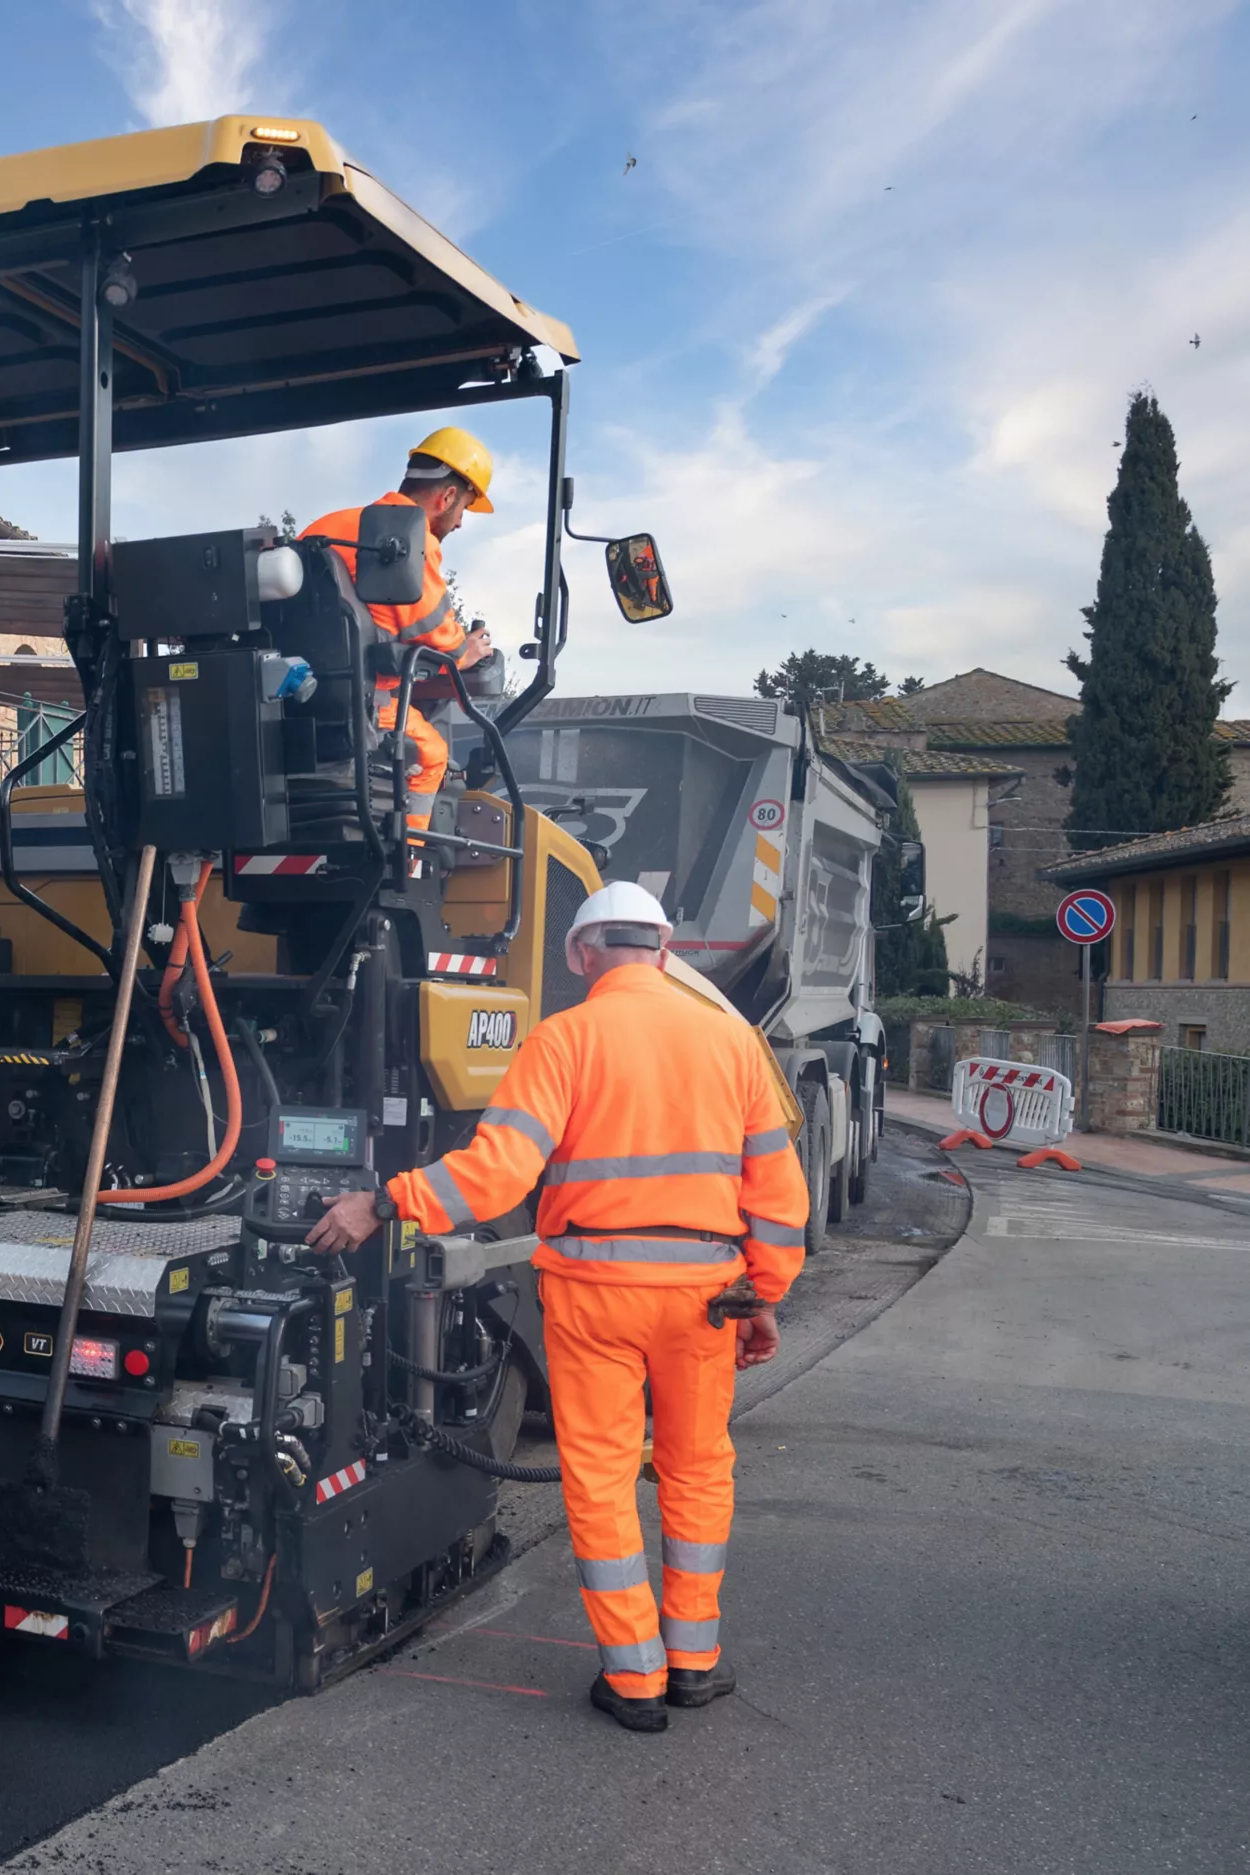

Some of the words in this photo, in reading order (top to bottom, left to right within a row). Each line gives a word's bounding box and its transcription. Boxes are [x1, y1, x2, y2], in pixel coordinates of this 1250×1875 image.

[757, 807, 776, 821] 80
[467, 1010, 511, 1047] AP400
[31, 1336, 47, 1351] VT
